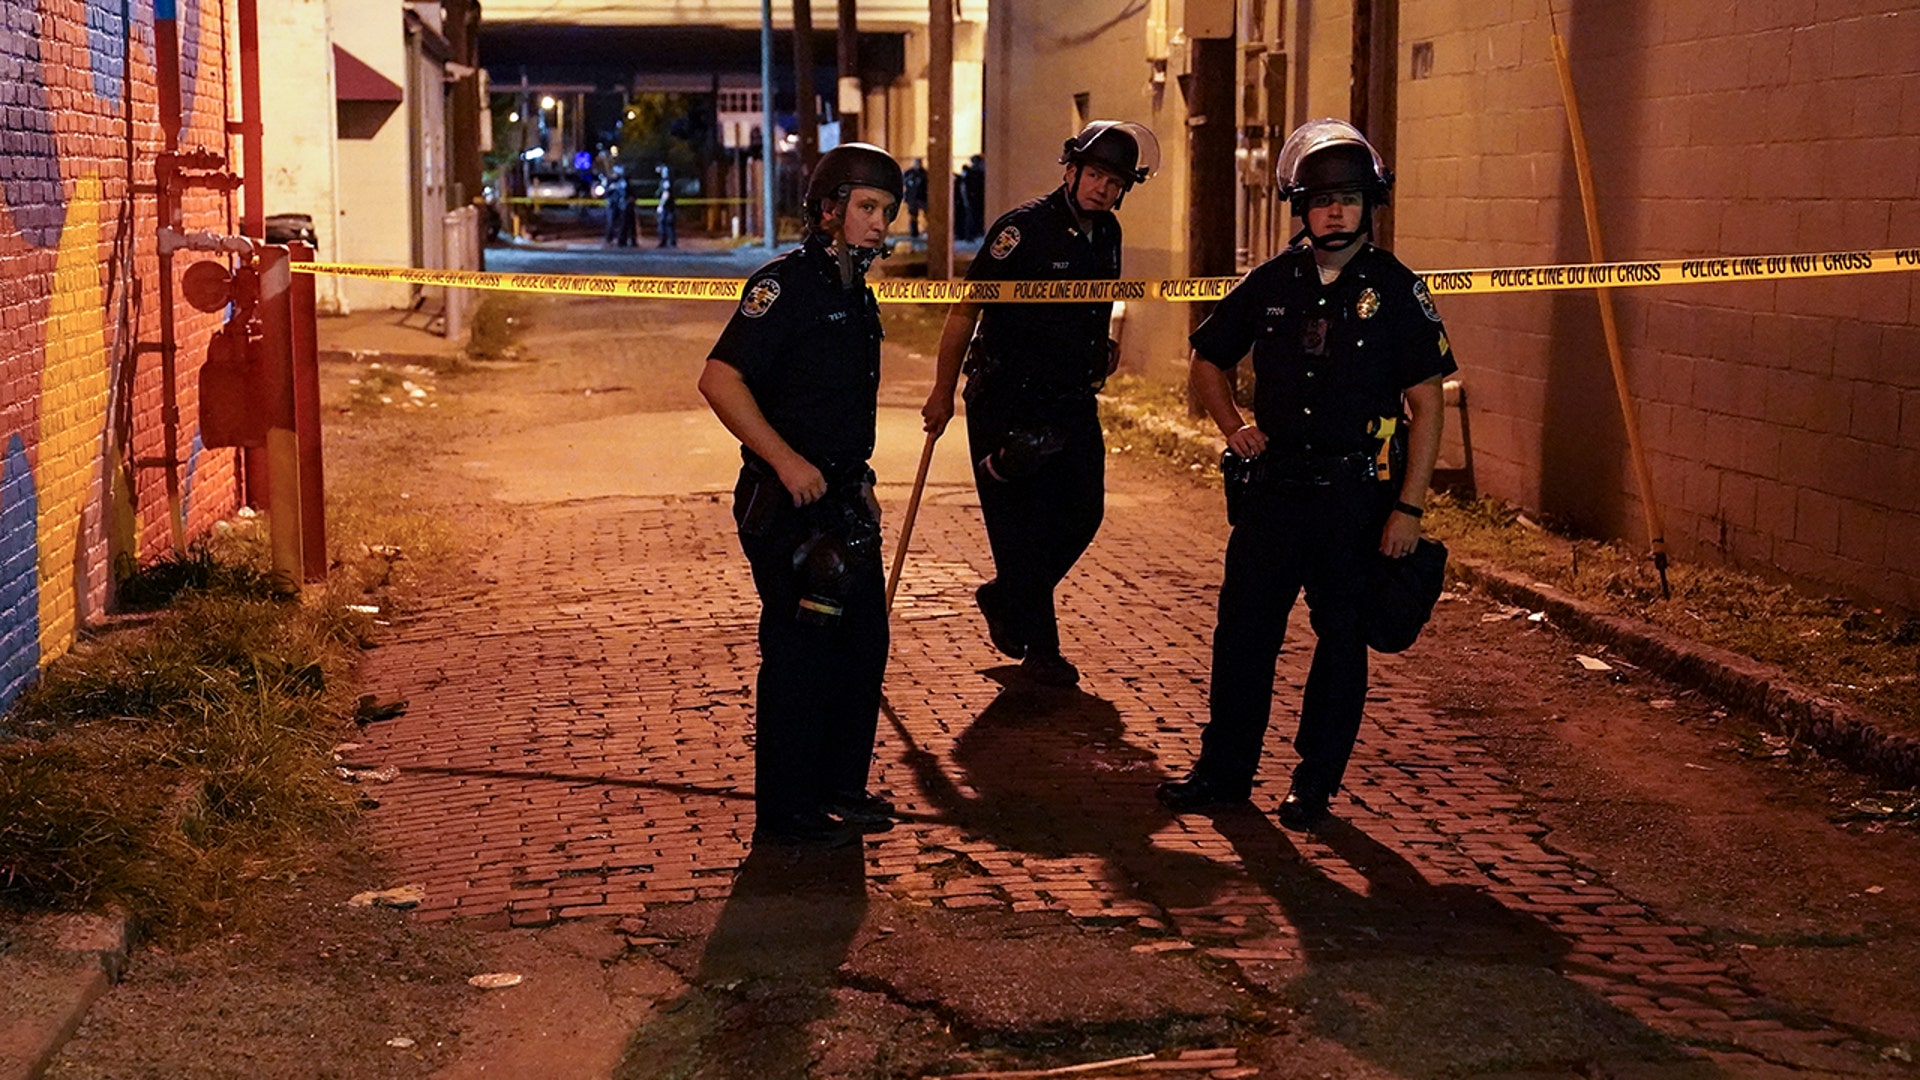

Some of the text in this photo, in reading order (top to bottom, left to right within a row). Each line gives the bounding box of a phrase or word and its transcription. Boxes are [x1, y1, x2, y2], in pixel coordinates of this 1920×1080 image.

[1682, 252, 1873, 278] POLICE LINE DO NOT CROSS
[512, 275, 618, 292] POLICE LINE DO NOT CROSS
[1490, 263, 1662, 287] POLICE LINE DO NOT CROSS
[627, 279, 739, 296] POLICE LINE DO NOT CROSS
[878, 282, 1001, 299] POLICE LINE DO NOT CROSS
[1014, 281, 1146, 298] POLICE LINE DO NOT CROSS
[1160, 280, 1198, 297] POLICE
[1198, 279, 1223, 296] LINE
[1433, 271, 1473, 290] CROSS
